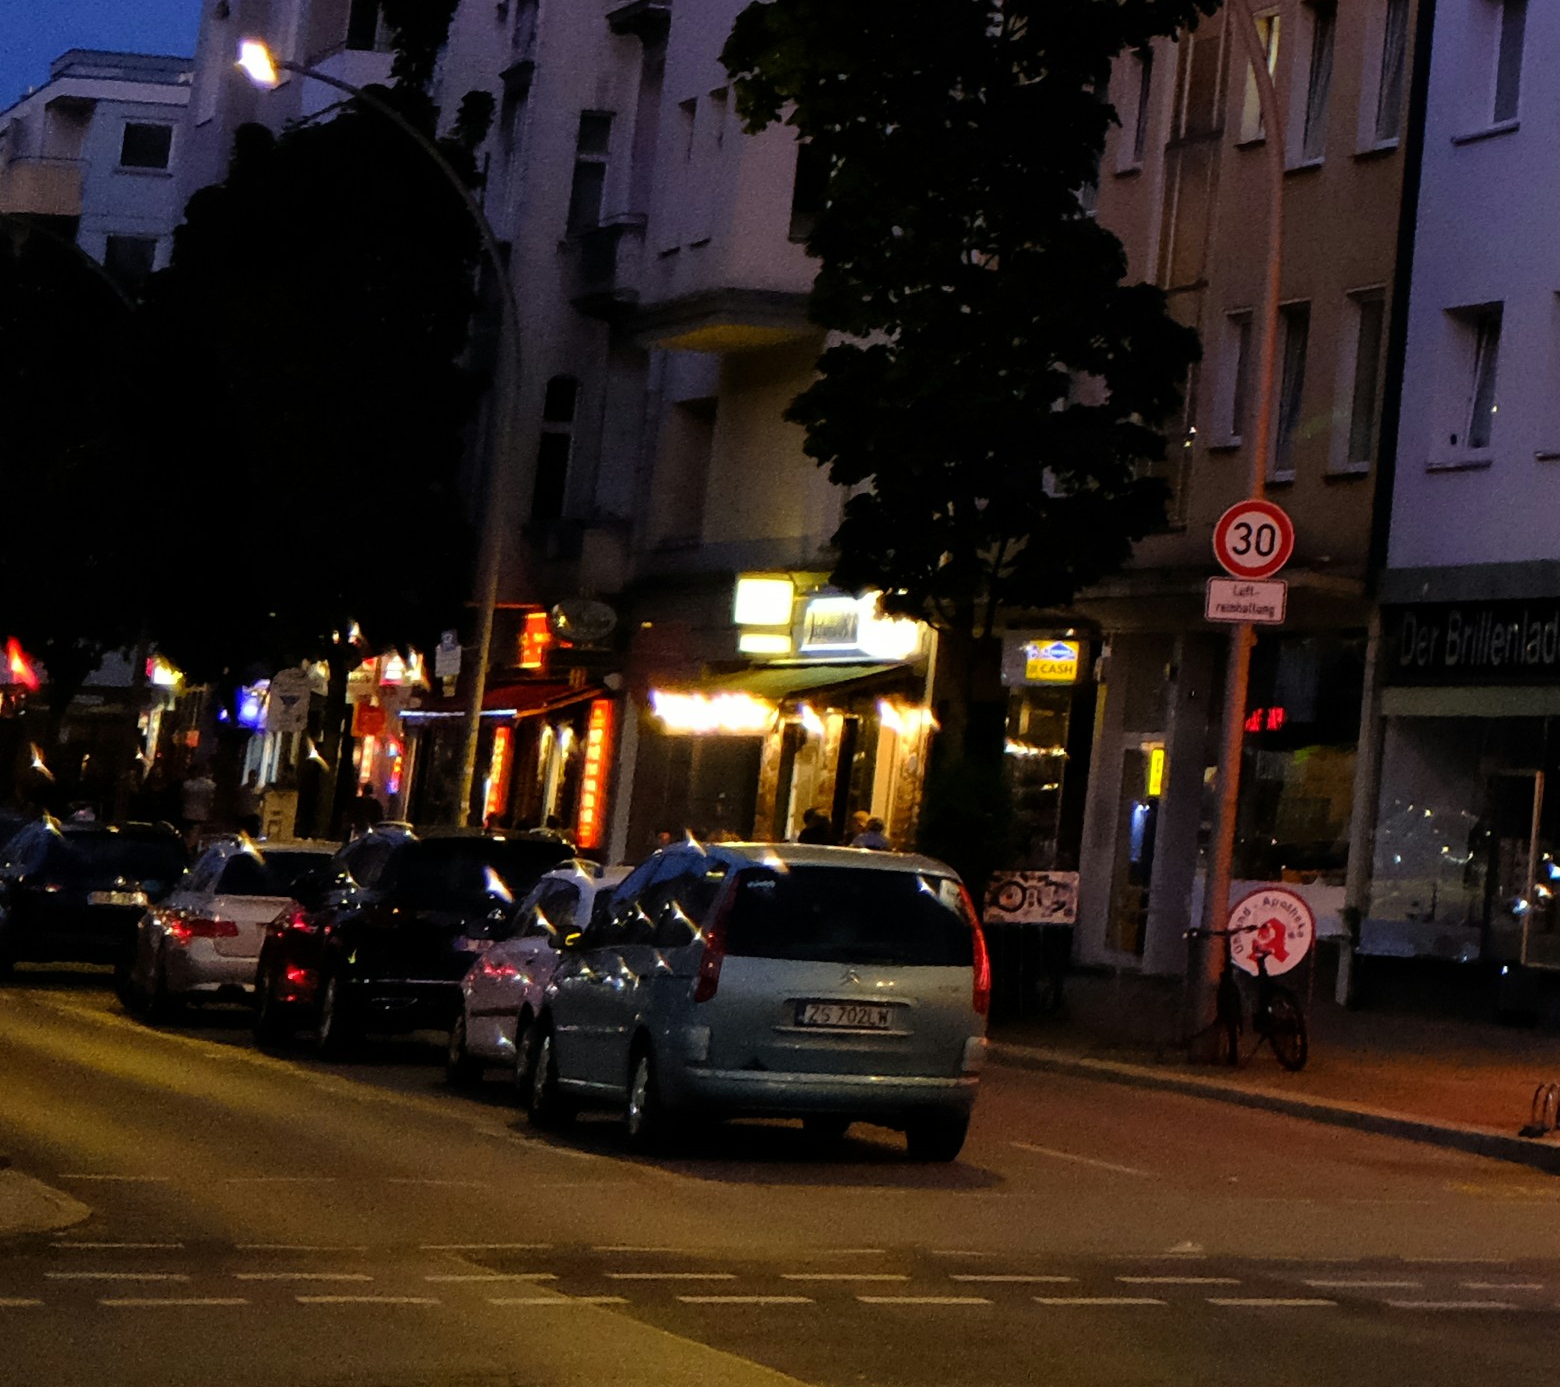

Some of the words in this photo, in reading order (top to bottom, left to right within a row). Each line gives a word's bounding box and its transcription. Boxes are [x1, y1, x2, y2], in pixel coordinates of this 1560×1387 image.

[1231, 522, 1277, 558] 30
[1233, 584, 1261, 597] Luft-
[1399, 609, 1441, 667] Der
[1040, 664, 1073, 675] CASH
